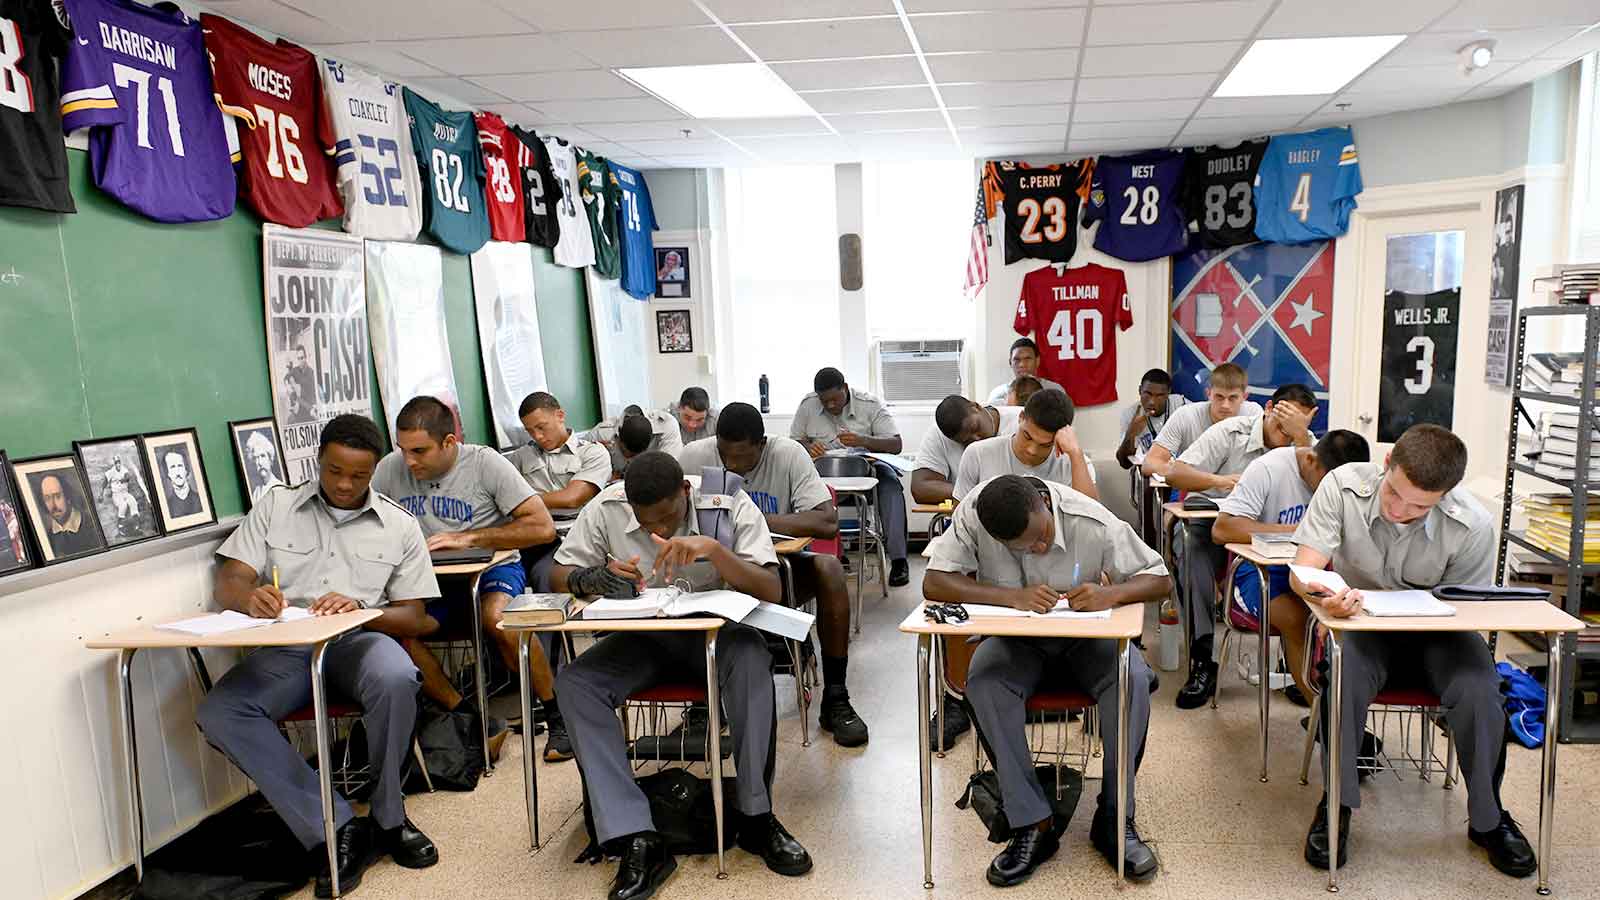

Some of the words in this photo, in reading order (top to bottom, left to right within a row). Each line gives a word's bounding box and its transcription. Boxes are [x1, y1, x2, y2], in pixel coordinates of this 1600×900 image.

[99, 21, 177, 70] DARRISAW
[248, 62, 292, 101] MOSES
[112, 62, 185, 157] 71
[349, 98, 389, 123] COAKLEY
[254, 103, 309, 184] 76
[1207, 154, 1251, 175] DUDLEY
[357, 133, 409, 207] 52
[432, 148, 472, 213] 82
[1131, 165, 1155, 179] WEST
[1017, 197, 1067, 244] 23
[1120, 185, 1160, 225] 28
[1204, 181, 1252, 230] 83
[1288, 173, 1312, 222] 4
[1052, 286, 1099, 300] TILLMAN
[1394, 307, 1431, 325] WELLS
[1433, 308, 1451, 324] JR.
[1047, 308, 1103, 360] 40
[313, 317, 368, 404] CASH
[1404, 336, 1436, 395] 3
[283, 423, 320, 450] FOLSOM
[399, 495, 427, 517] ORK
[431, 495, 473, 522] UNION
